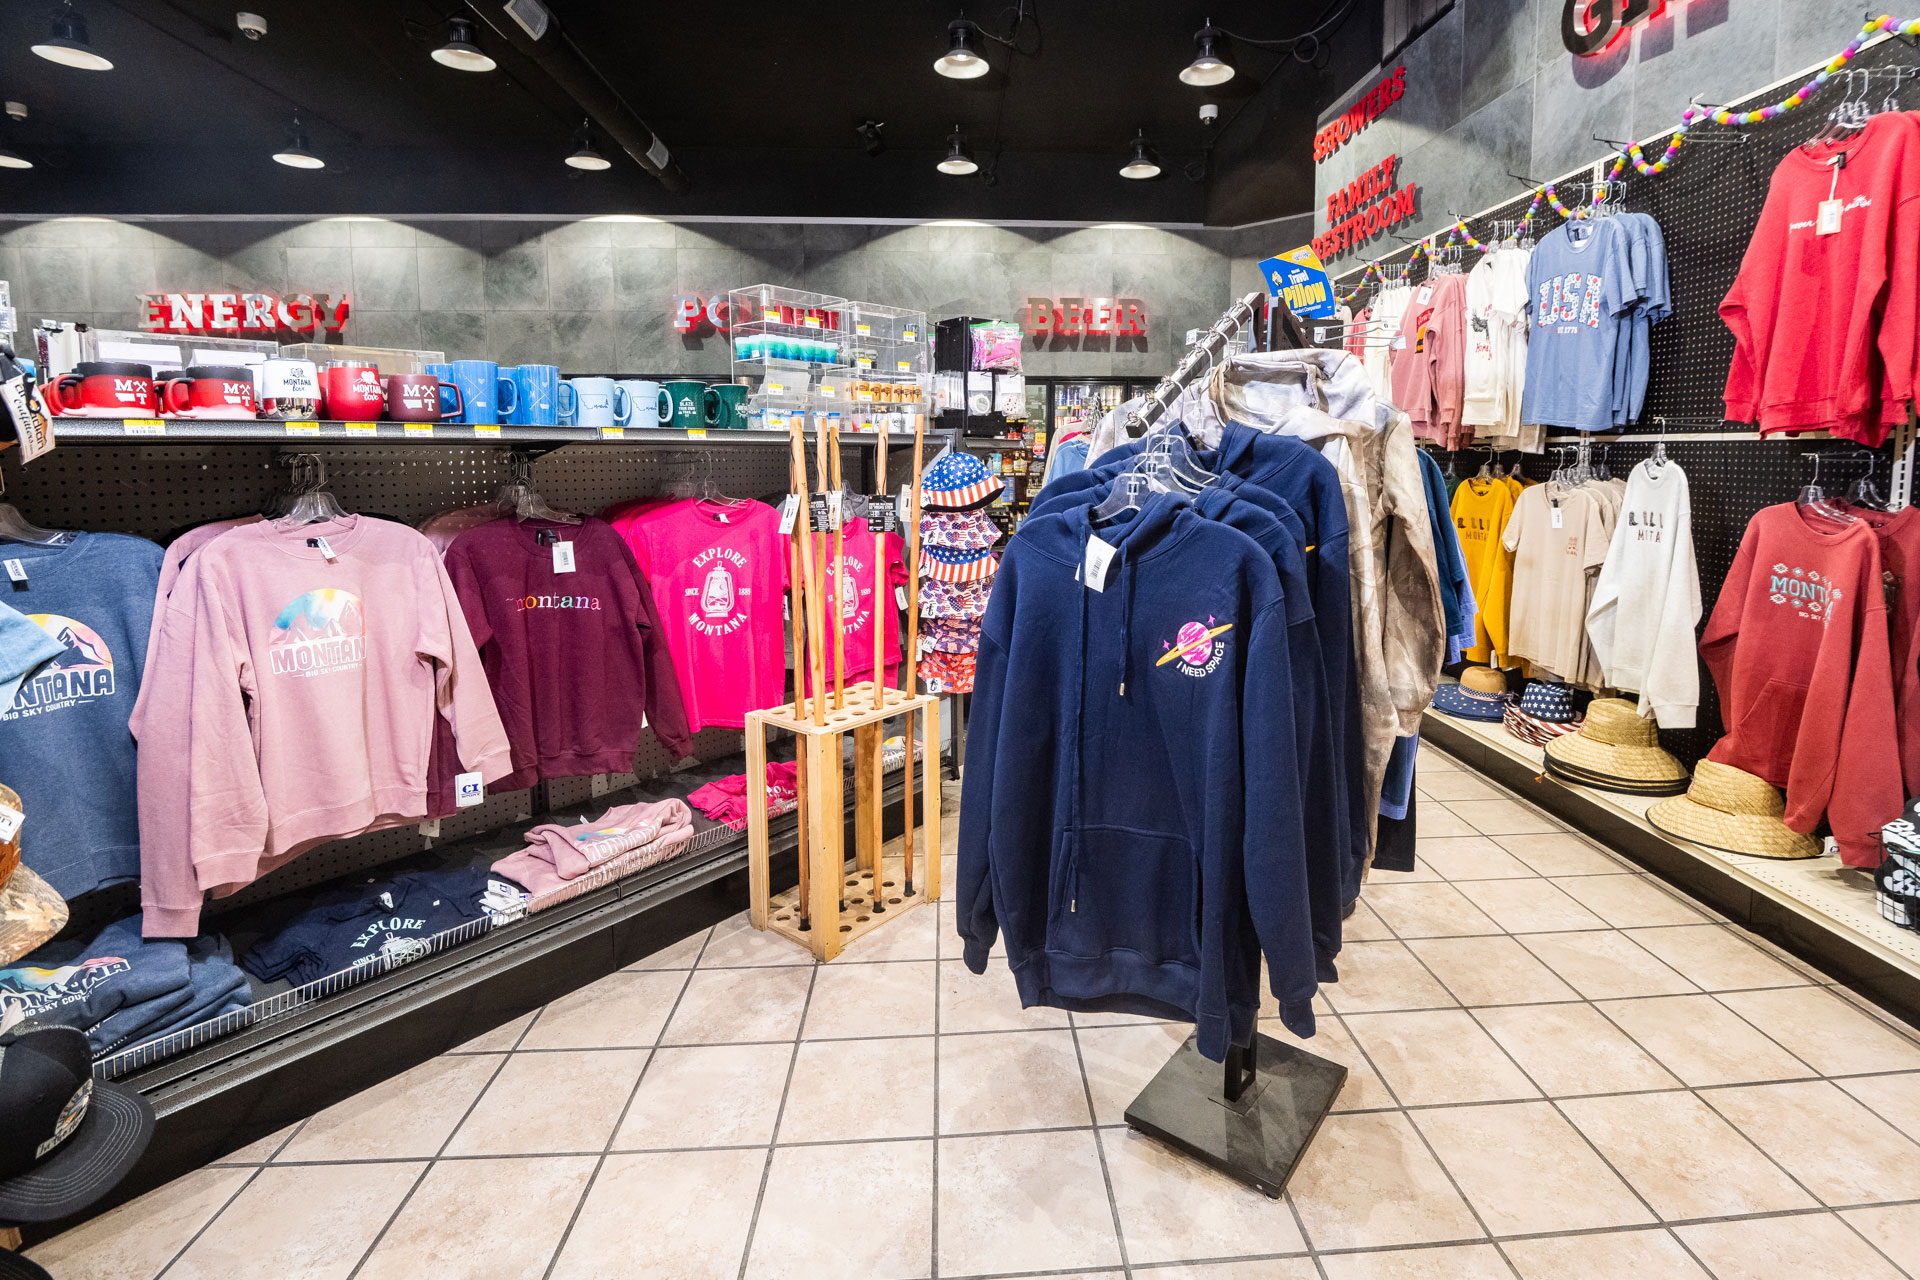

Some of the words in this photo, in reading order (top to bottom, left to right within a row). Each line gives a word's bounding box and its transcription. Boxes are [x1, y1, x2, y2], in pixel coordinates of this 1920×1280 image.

[1313, 66, 1405, 161] SHOWERS
[1326, 154, 1395, 223] FAMILY
[136, 293, 346, 329] ENERGY
[1283, 281, 1326, 310] Pillow
[1539, 273, 1602, 328] USA
[1028, 297, 1146, 331] BEER
[692, 547, 747, 569] EXPLORE
[684, 588, 699, 597] SINCE
[687, 612, 748, 636] MONTANA
[270, 636, 367, 675] MONTAN
[1176, 661, 1183, 669] I
[1181, 663, 1206, 677] NEED
[1205, 641, 1225, 674] SPACE
[3, 712, 19, 721] BIG
[22, 706, 43, 717] SKY
[45, 699, 76, 712] COUNTRY
[351, 917, 426, 949] EXPLORE
[38, 1001, 59, 1014] SKY
